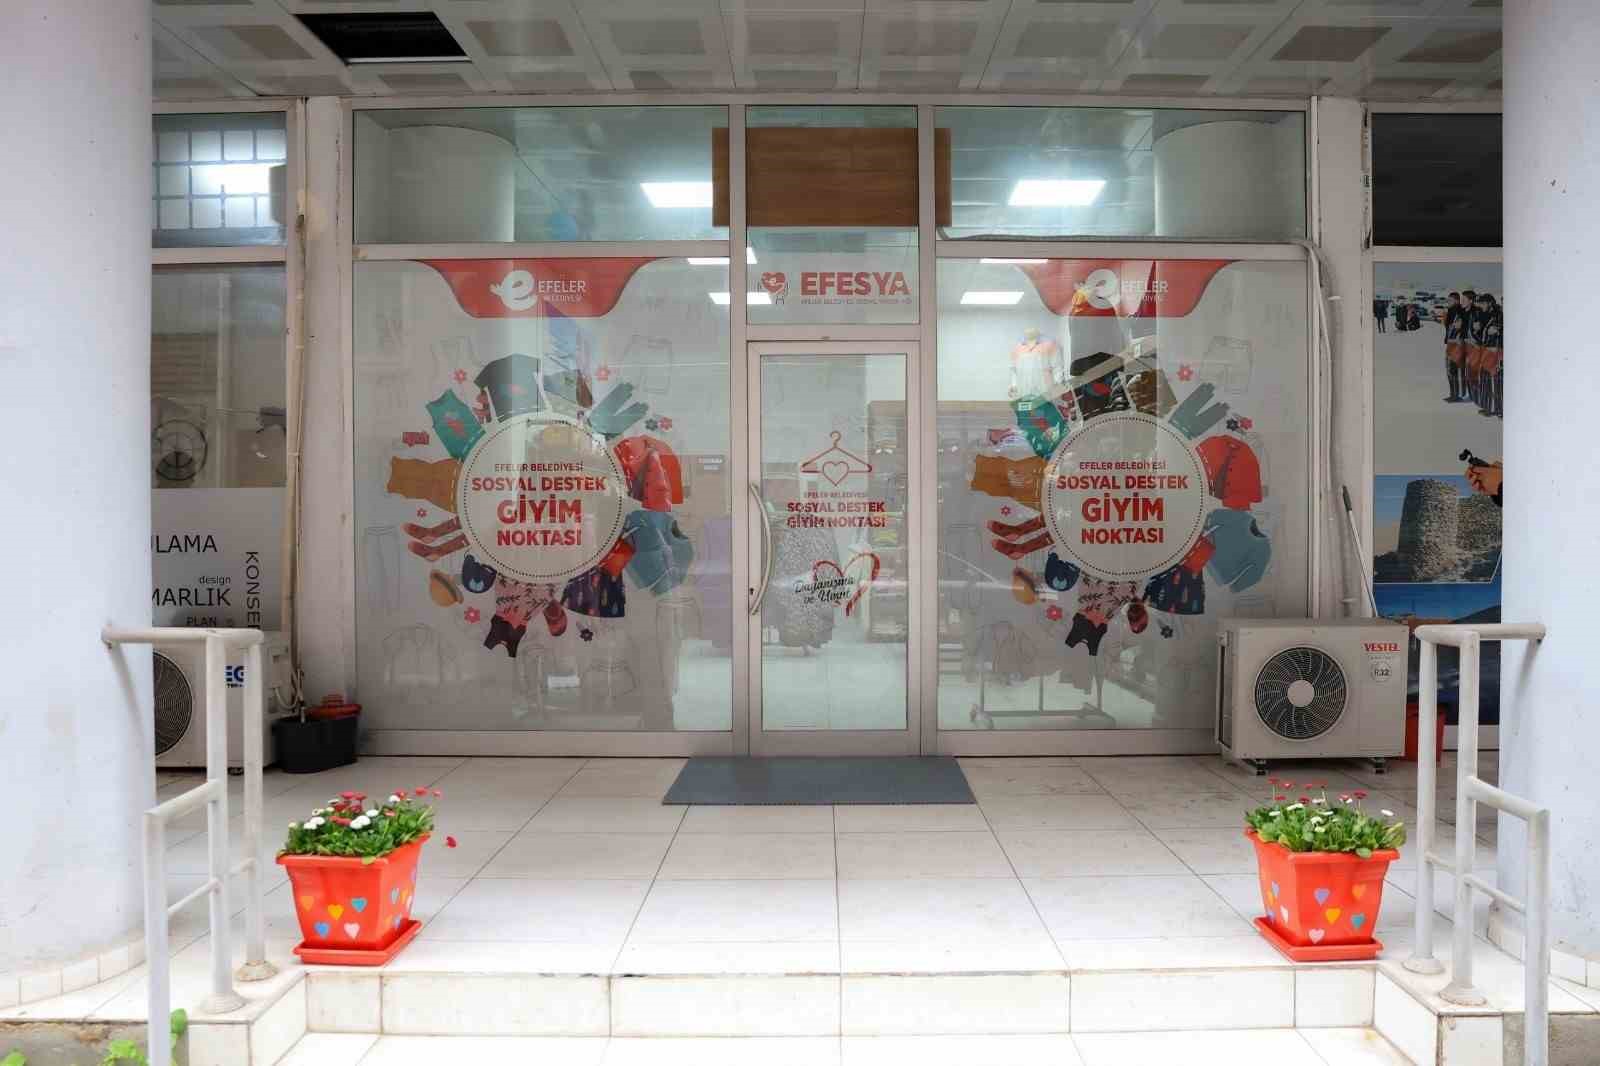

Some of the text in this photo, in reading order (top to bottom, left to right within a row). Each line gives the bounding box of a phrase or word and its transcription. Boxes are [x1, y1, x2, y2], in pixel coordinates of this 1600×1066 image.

[538, 280, 586, 293] EFELER
[801, 271, 912, 296] EFESYA
[1121, 280, 1168, 293] EFELER
[495, 461, 584, 472] EFELER BELEDİYESİ
[1079, 459, 1166, 470] EFELER BELEDİYESİ
[472, 476, 607, 491] SOSYAL DESTEK
[1057, 475, 1189, 490] SOSYAL DESTEK
[497, 494, 582, 524] GİYİM
[787, 502, 885, 512] SOSYAL DESTEK
[1081, 493, 1164, 522] GİYİM
[787, 513, 886, 528] GİYİM NOKTASI
[151, 534, 218, 553] LAMA
[497, 530, 582, 546] NOKTASI
[1081, 528, 1164, 544] NOKTASI
[199, 575, 231, 586] design
[186, 616, 217, 627] PLAN
[1363, 642, 1400, 652] VESTEL
